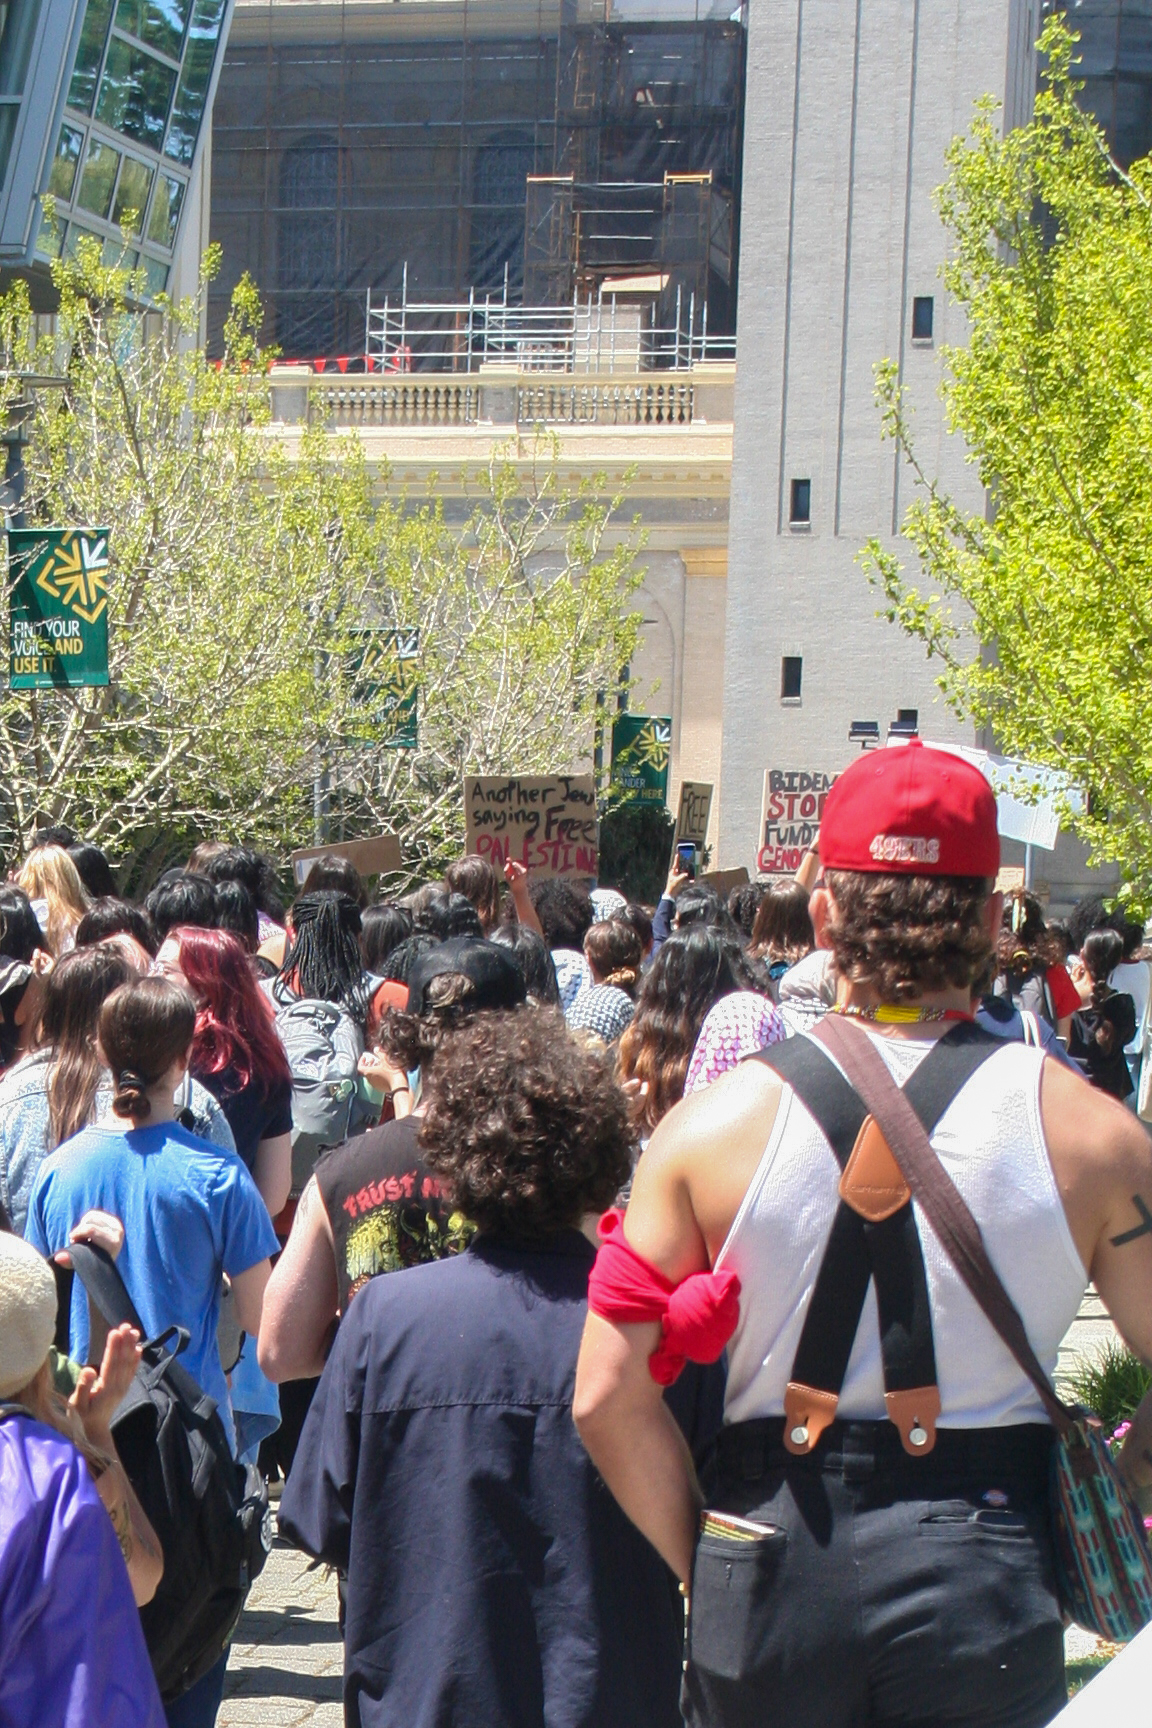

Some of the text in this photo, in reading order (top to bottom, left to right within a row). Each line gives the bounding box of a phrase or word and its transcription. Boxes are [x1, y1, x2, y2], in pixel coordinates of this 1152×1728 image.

[14, 619, 80, 638] FIND YOUR
[55, 638, 84, 655] AND
[14, 657, 39, 674] USE
[472, 780, 556, 804] Another
[558, 777, 595, 806] Jew
[473, 804, 596, 843] saying Free
[678, 791, 708, 838] FREE
[476, 834, 597, 875] PALESTINE
[869, 833, 940, 864] 49ERS
[343, 1170, 418, 1219] TRUST
